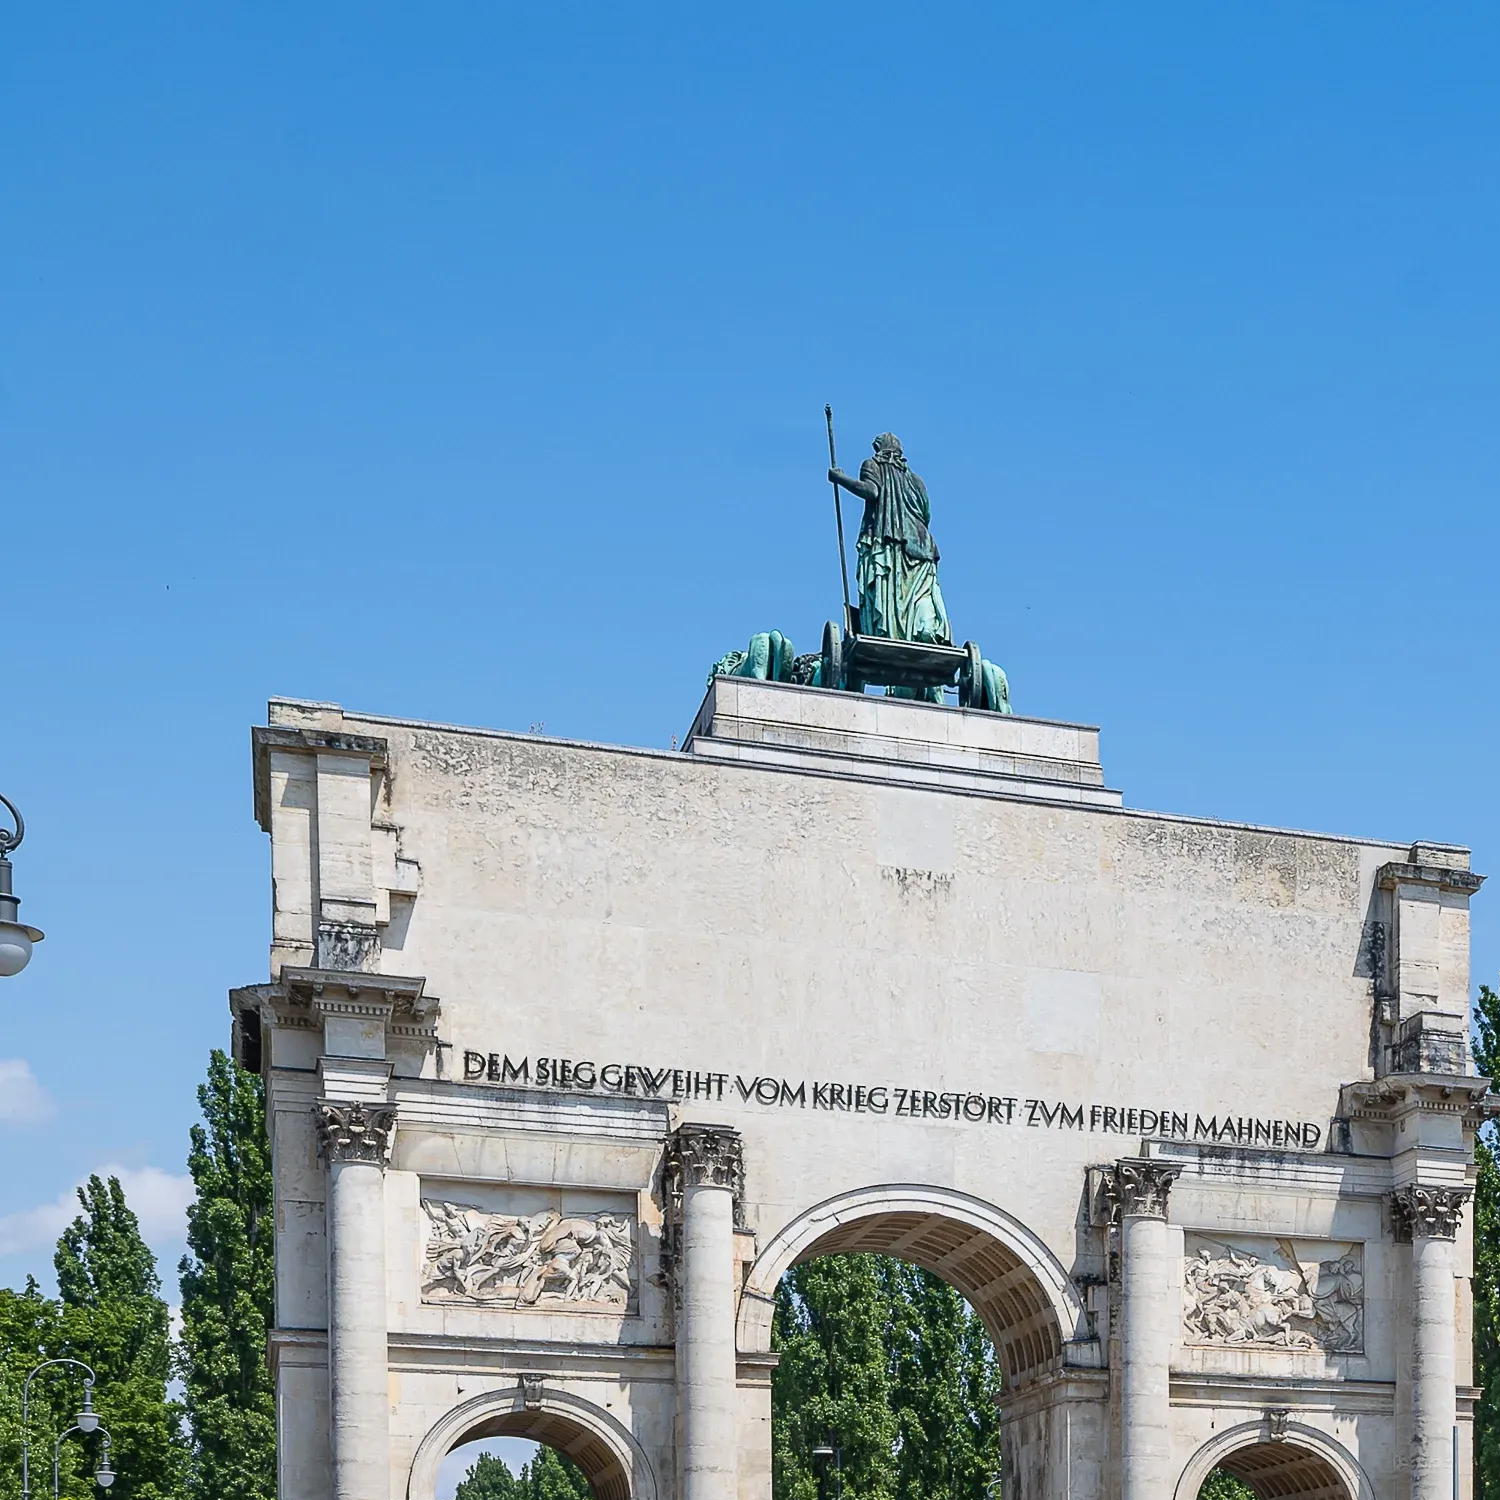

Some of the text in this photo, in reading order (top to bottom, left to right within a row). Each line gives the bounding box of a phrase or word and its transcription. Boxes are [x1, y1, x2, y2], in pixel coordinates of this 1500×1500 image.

[463, 1051, 1322, 1148] DEM SIEG GEWEIHT VOM KRIEG ZERSTÖRT ZVM FRIEDEN MAHNEND
